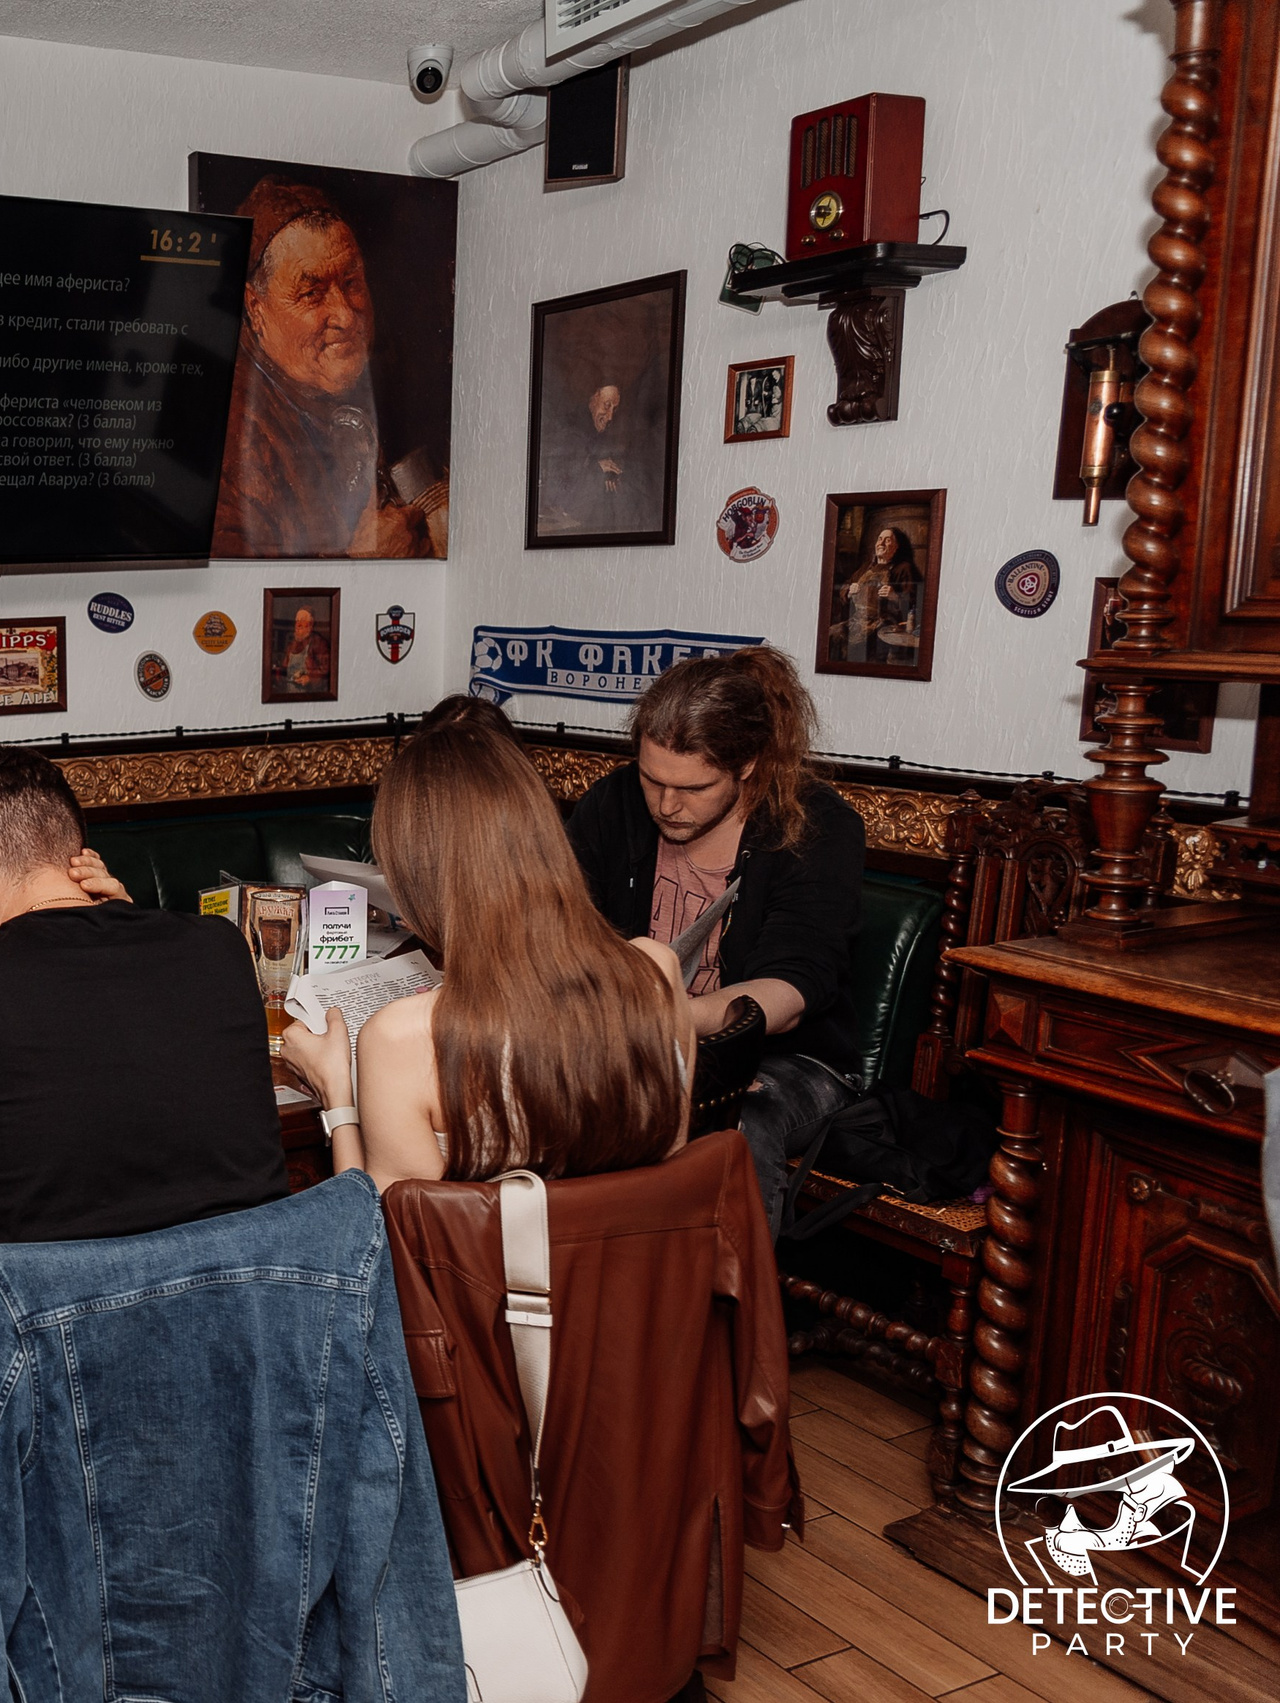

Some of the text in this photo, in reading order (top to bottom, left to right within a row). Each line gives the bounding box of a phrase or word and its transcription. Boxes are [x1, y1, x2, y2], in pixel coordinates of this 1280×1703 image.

[25, 274, 53, 287] имя
[56, 273, 130, 293] афериста?
[8, 315, 62, 331] кредит,
[66, 318, 105, 331] стали
[109, 318, 178, 336] требовать
[181, 324, 188, 335] с
[32, 358, 83, 373] другие
[86, 360, 132, 374] имена,
[135, 362, 177, 376] кроме
[181, 363, 204, 376] тех,
[63, 398, 144, 411] «человеком
[147, 400, 162, 411] из
[77, 414, 89, 430] (3
[93, 414, 136, 431] балла)
[13, 436, 74, 451] говорил,
[78, 437, 101, 448] что
[104, 438, 130, 452] ему
[132, 438, 174, 452] нужно
[33, 455, 74, 466] ответ.
[78, 452, 90, 468] (3
[94, 452, 137, 468] балла)
[38, 472, 95, 489] Аваруа?
[97, 472, 109, 488] (3
[113, 471, 155, 488] балла)
[722, 496, 766, 522] HOBGOBLIN
[90, 601, 132, 622] RUDDLES
[507, 640, 553, 668] ФК
[21, 692, 53, 705] ALE
[319, 935, 355, 944] фрибет
[312, 944, 360, 960] 7777
